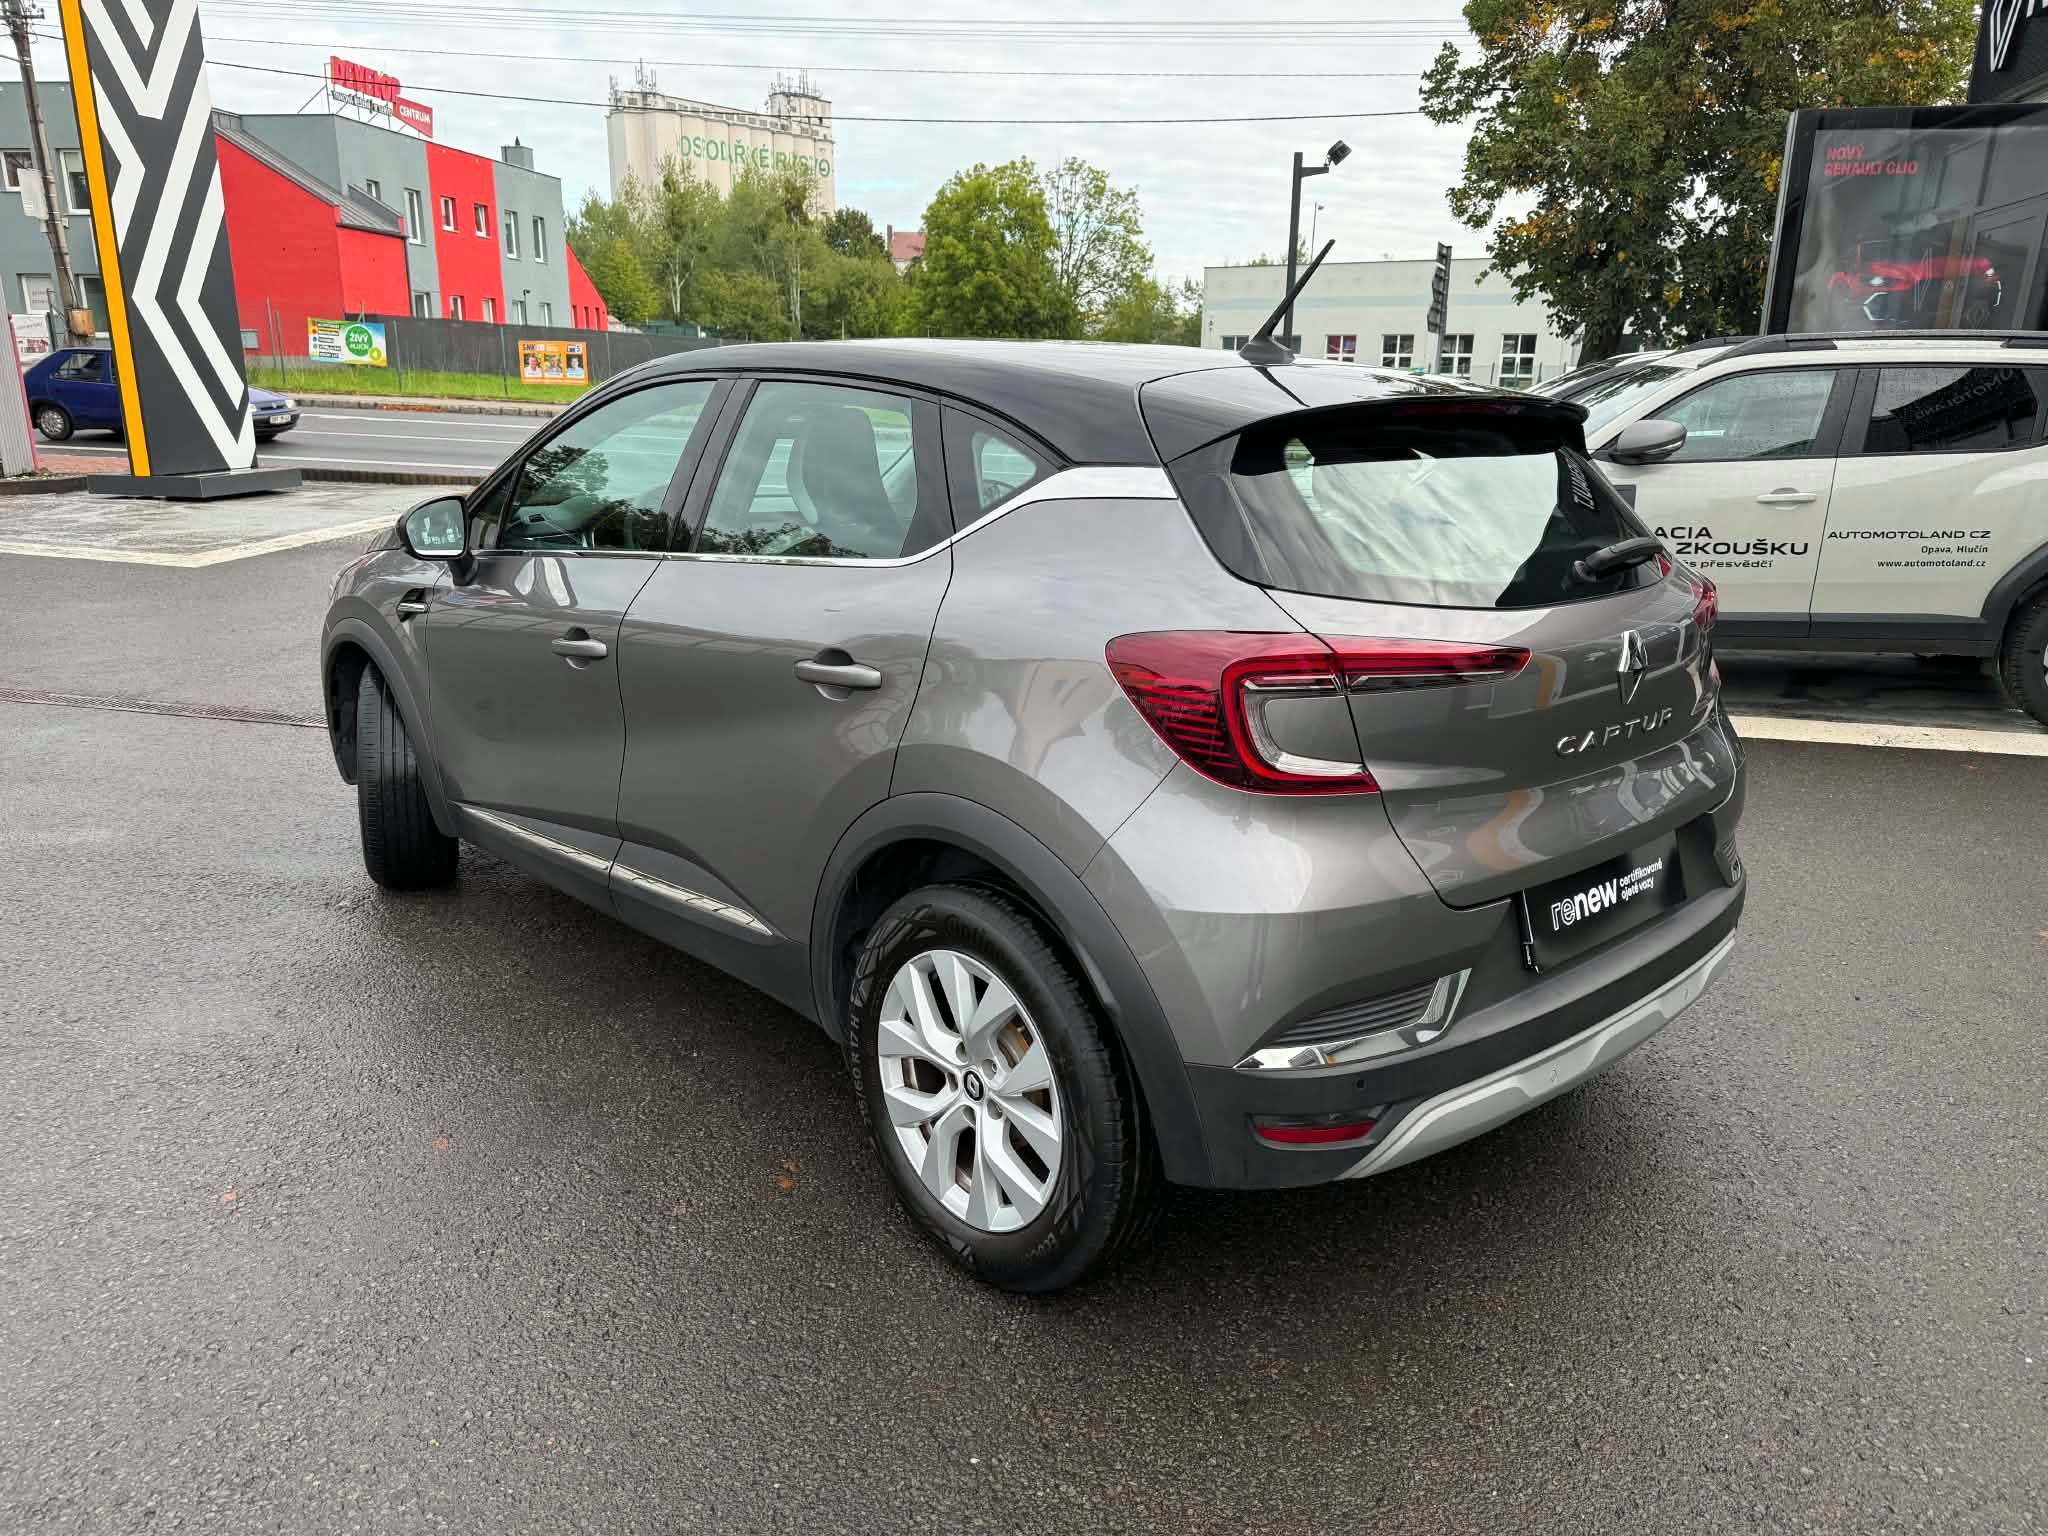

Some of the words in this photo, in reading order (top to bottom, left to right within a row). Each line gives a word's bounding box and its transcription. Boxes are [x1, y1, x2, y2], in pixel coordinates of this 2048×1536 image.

[400, 105, 431, 125] CENTRUM
[1824, 160, 1886, 177] RENAULT
[1886, 159, 1920, 176] CLIO
[1654, 526, 1713, 539] ACIA
[1827, 530, 1965, 540] AUTOMOTOLAND
[1969, 530, 1992, 540] CZ
[1675, 538, 1809, 556] ZKOUŠKU
[1921, 545, 1954, 555] Opava,
[1956, 545, 1988, 554] Hlučín
[1700, 559, 1774, 569] přesvědčí
[1877, 558, 1986, 568] www.automotoland.cz
[1556, 707, 1673, 755] CAPTUR
[1619, 857, 1663, 888] certifikované
[1621, 882, 1639, 901] ojeté
[1638, 876, 1655, 892] vozy
[1550, 878, 1617, 931] renew
